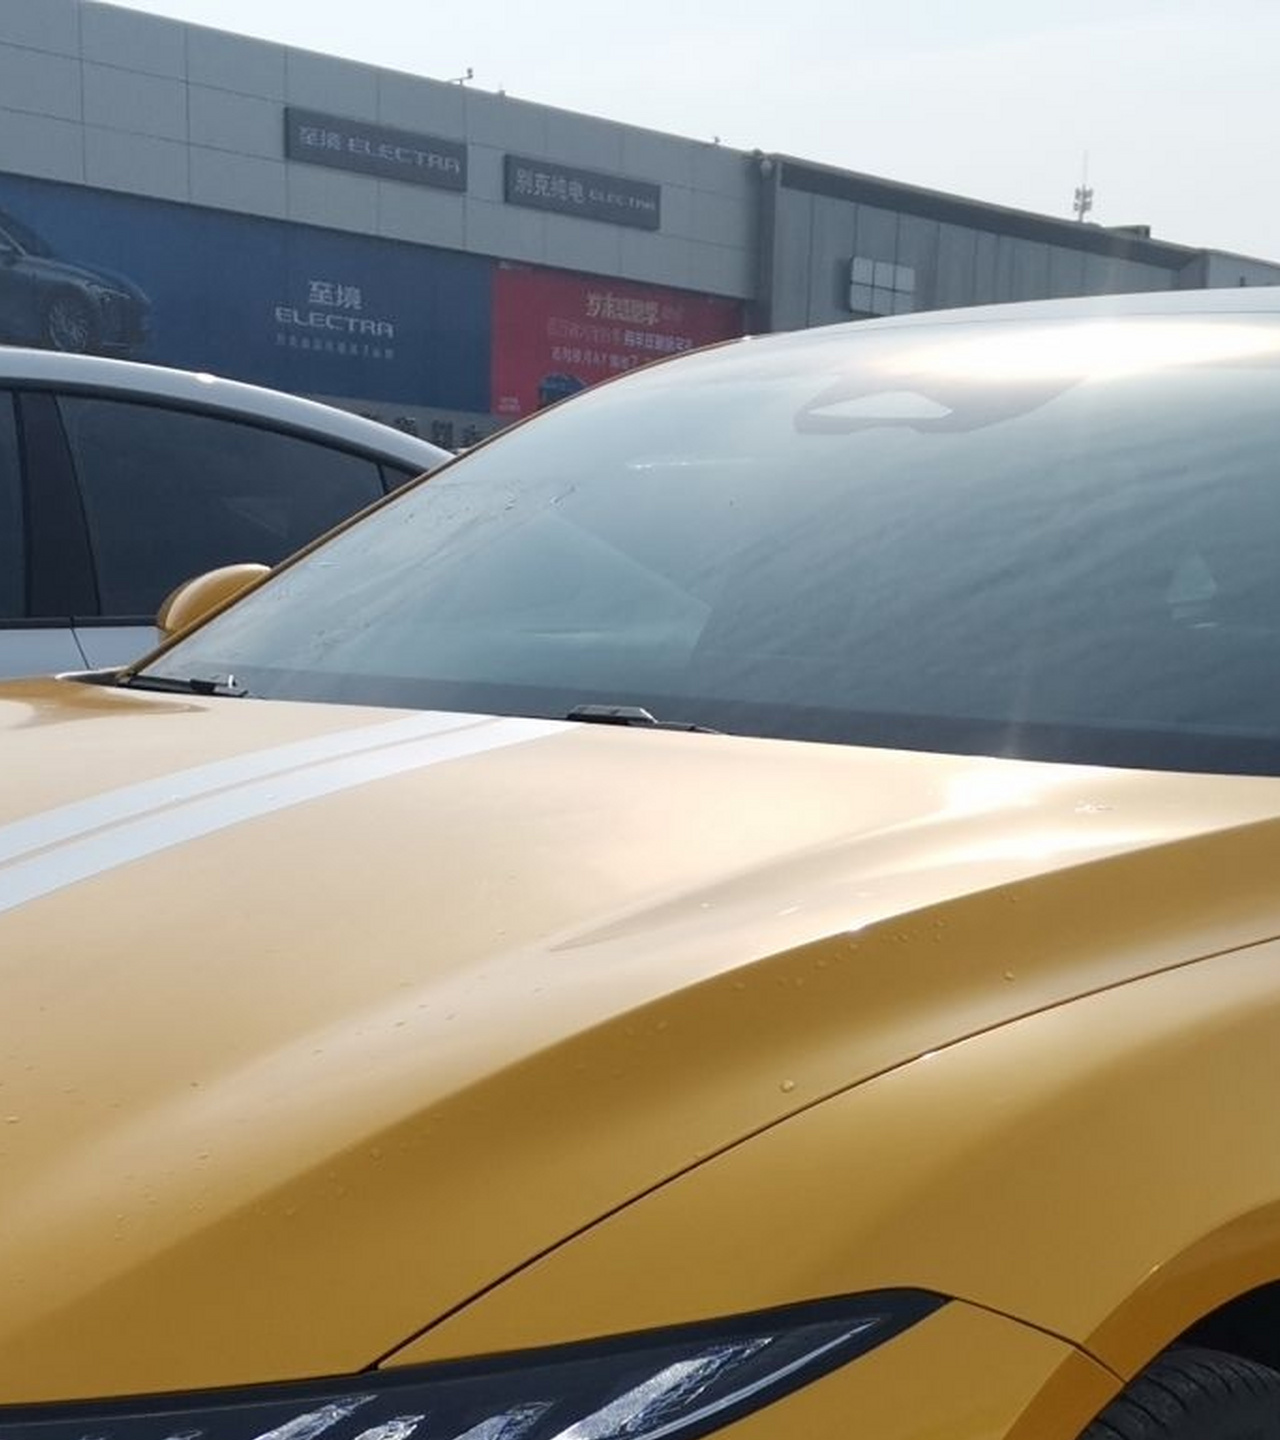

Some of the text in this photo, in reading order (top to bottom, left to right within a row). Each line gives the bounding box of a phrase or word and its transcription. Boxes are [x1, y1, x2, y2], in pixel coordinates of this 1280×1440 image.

[348, 136, 460, 173] ELECTRA
[309, 280, 363, 309] 至境
[275, 306, 394, 338] ELECTRA
